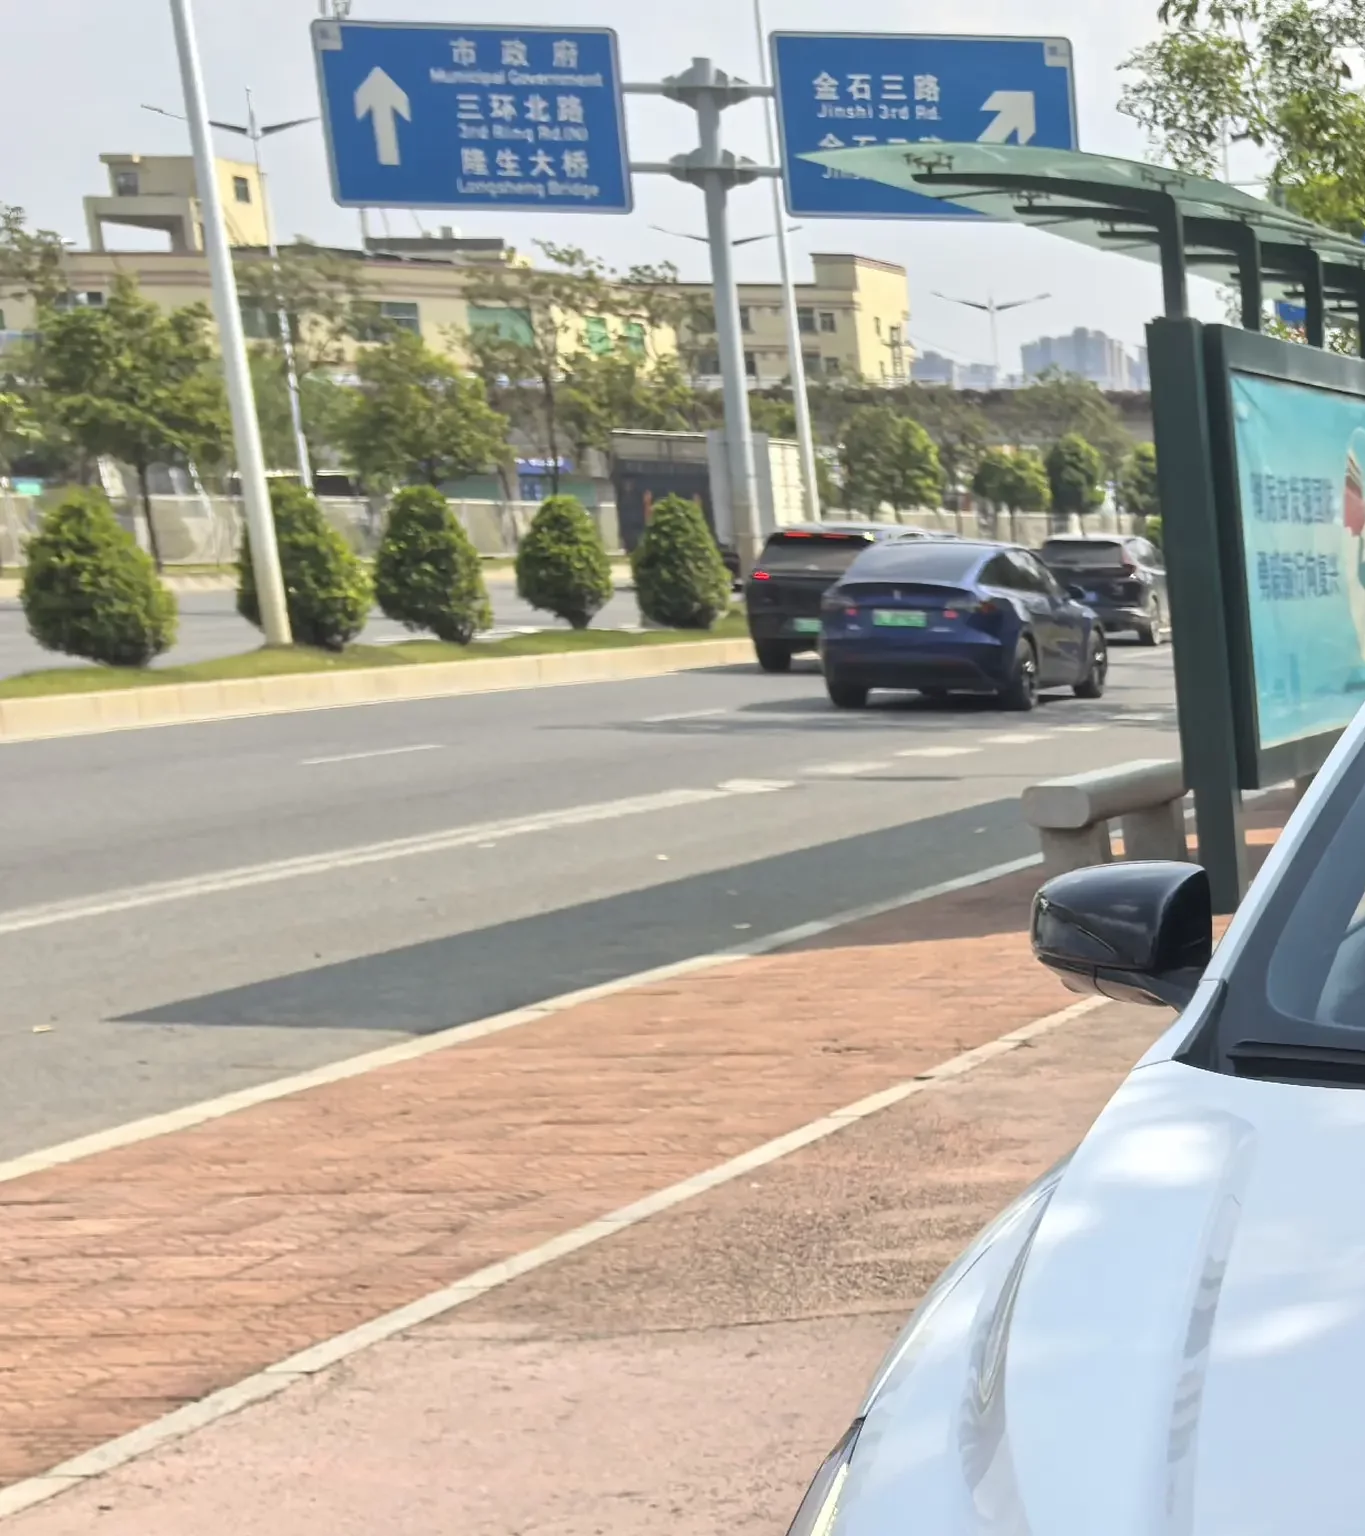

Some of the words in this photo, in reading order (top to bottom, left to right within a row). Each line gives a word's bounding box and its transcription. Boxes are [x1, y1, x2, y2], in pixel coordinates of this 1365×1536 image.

[449, 37, 578, 69] 市政府
[429, 67, 506, 87] Municipal
[507, 68, 603, 87] Government
[812, 70, 941, 103] 金石三路
[456, 93, 585, 123] 三环北路
[817, 103, 873, 119] Jinshi
[878, 104, 910, 120] 3rd
[915, 104, 942, 121] Rd.
[460, 148, 590, 178] 隆生大桥
[456, 177, 546, 198] Longsheng
[547, 179, 600, 200] Bridge
